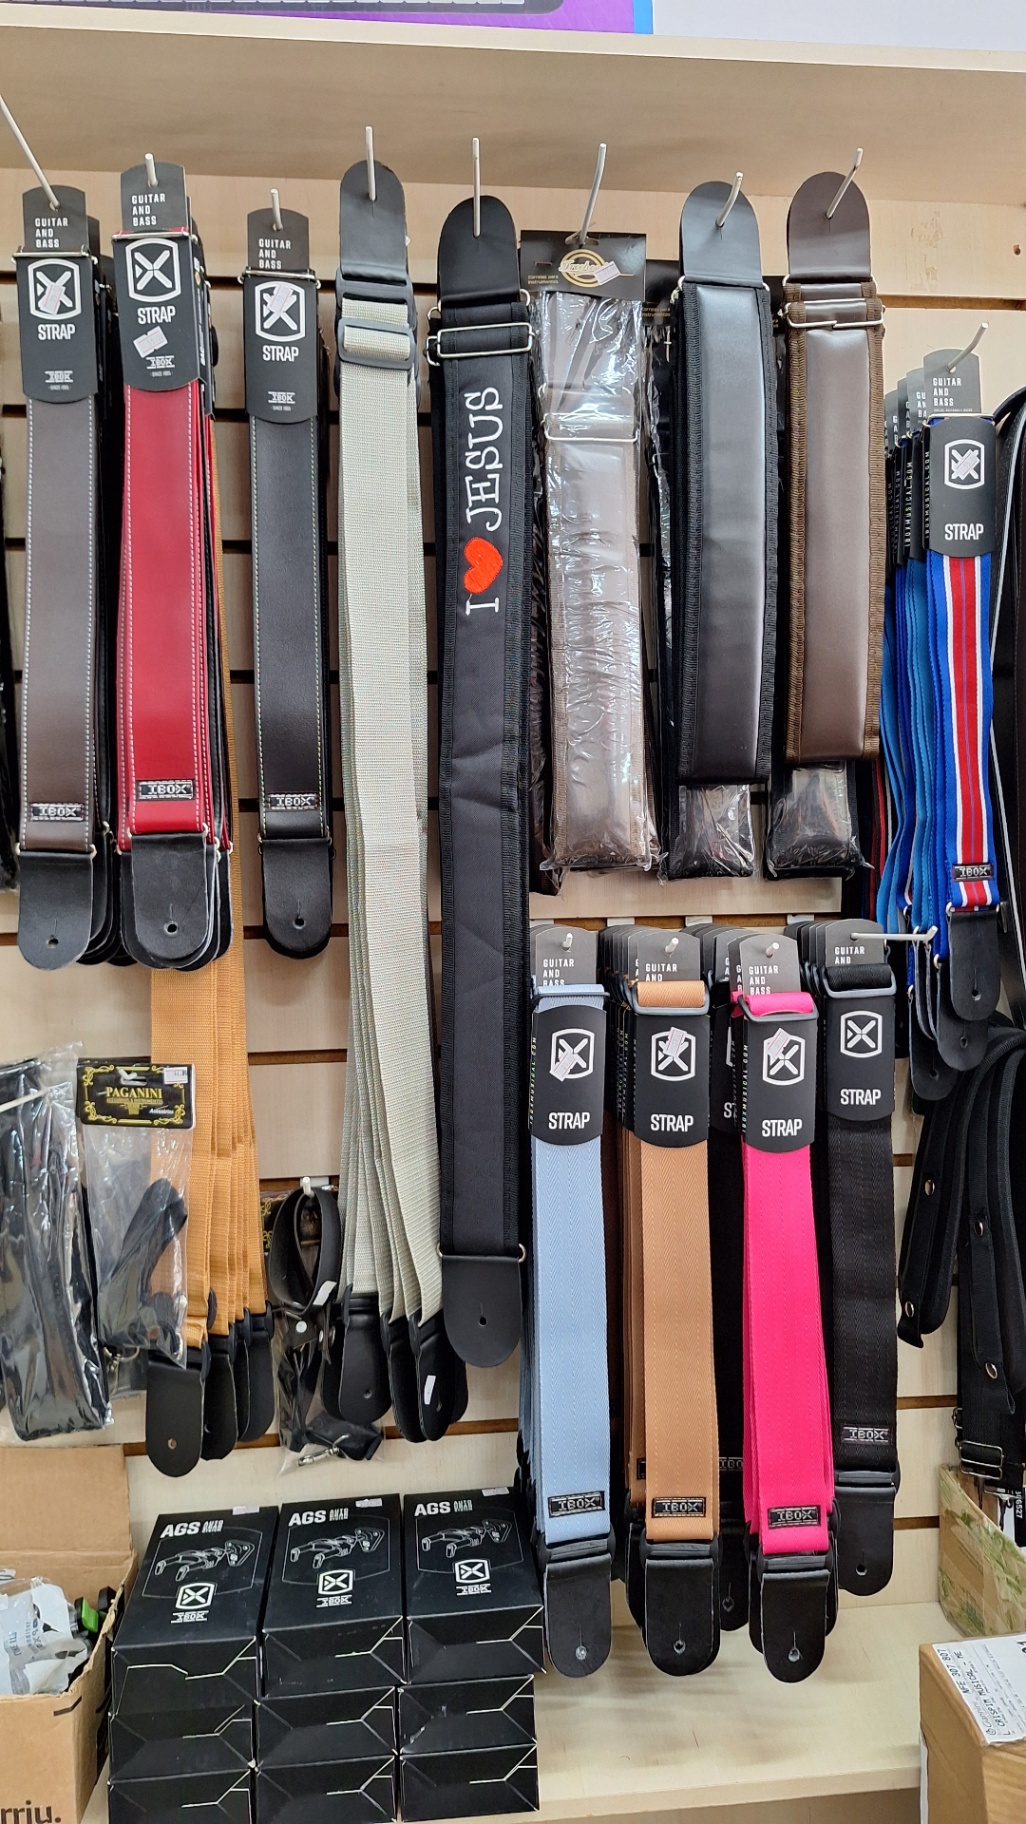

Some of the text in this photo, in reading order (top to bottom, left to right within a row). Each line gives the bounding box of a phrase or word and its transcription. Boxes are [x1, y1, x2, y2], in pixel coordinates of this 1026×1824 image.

[132, 194, 166, 204] GUITAR
[132, 206, 150, 215] AND
[35, 218, 68, 227] GUITAR
[133, 216, 156, 226] BASS
[36, 229, 53, 237] AND
[36, 239, 59, 248] BASS
[259, 239, 291, 249] GUITAR
[259, 249, 276, 258] AND
[259, 260, 281, 269] BASS
[137, 306, 175, 324] STRAP
[38, 324, 75, 340] STRAP
[263, 345, 299, 362] STRAP
[933, 377, 961, 386] GUITAR
[933, 387, 949, 396] AND
[934, 397, 953, 406] BASS
[464, 387, 504, 616] I JESUS
[945, 523, 984, 541] STRAP
[146, 782, 190, 797] IBOX
[274, 795, 314, 808] IBOX
[38, 804, 80, 820] IBOX
[958, 866, 990, 879] IBOX
[834, 946, 865, 955] GUITAR
[543, 958, 574, 968] GUITAR
[834, 956, 851, 964] AND
[645, 963, 677, 972] GUITAR
[748, 965, 779, 975] GUITAR
[543, 969, 560, 978] AND
[645, 973, 663, 982] AND
[749, 976, 766, 985] AND
[750, 986, 771, 995] BASS
[106, 1086, 163, 1098] PAGANINI
[840, 1089, 882, 1105] STRAP
[548, 1112, 591, 1130] STRAP
[651, 1114, 694, 1132] STRAP
[762, 1118, 803, 1137] STRAP
[847, 1427, 888, 1440] IBOX
[719, 1458, 743, 1469] IBO
[414, 1502, 451, 1516] AGS
[556, 1495, 599, 1512] IBOX
[659, 1500, 701, 1514] IBOX
[288, 1510, 326, 1527] AGS
[775, 1508, 816, 1523] IBOX
[160, 1521, 201, 1538] AGS
[966, 1669, 986, 1696] MUSICAL
